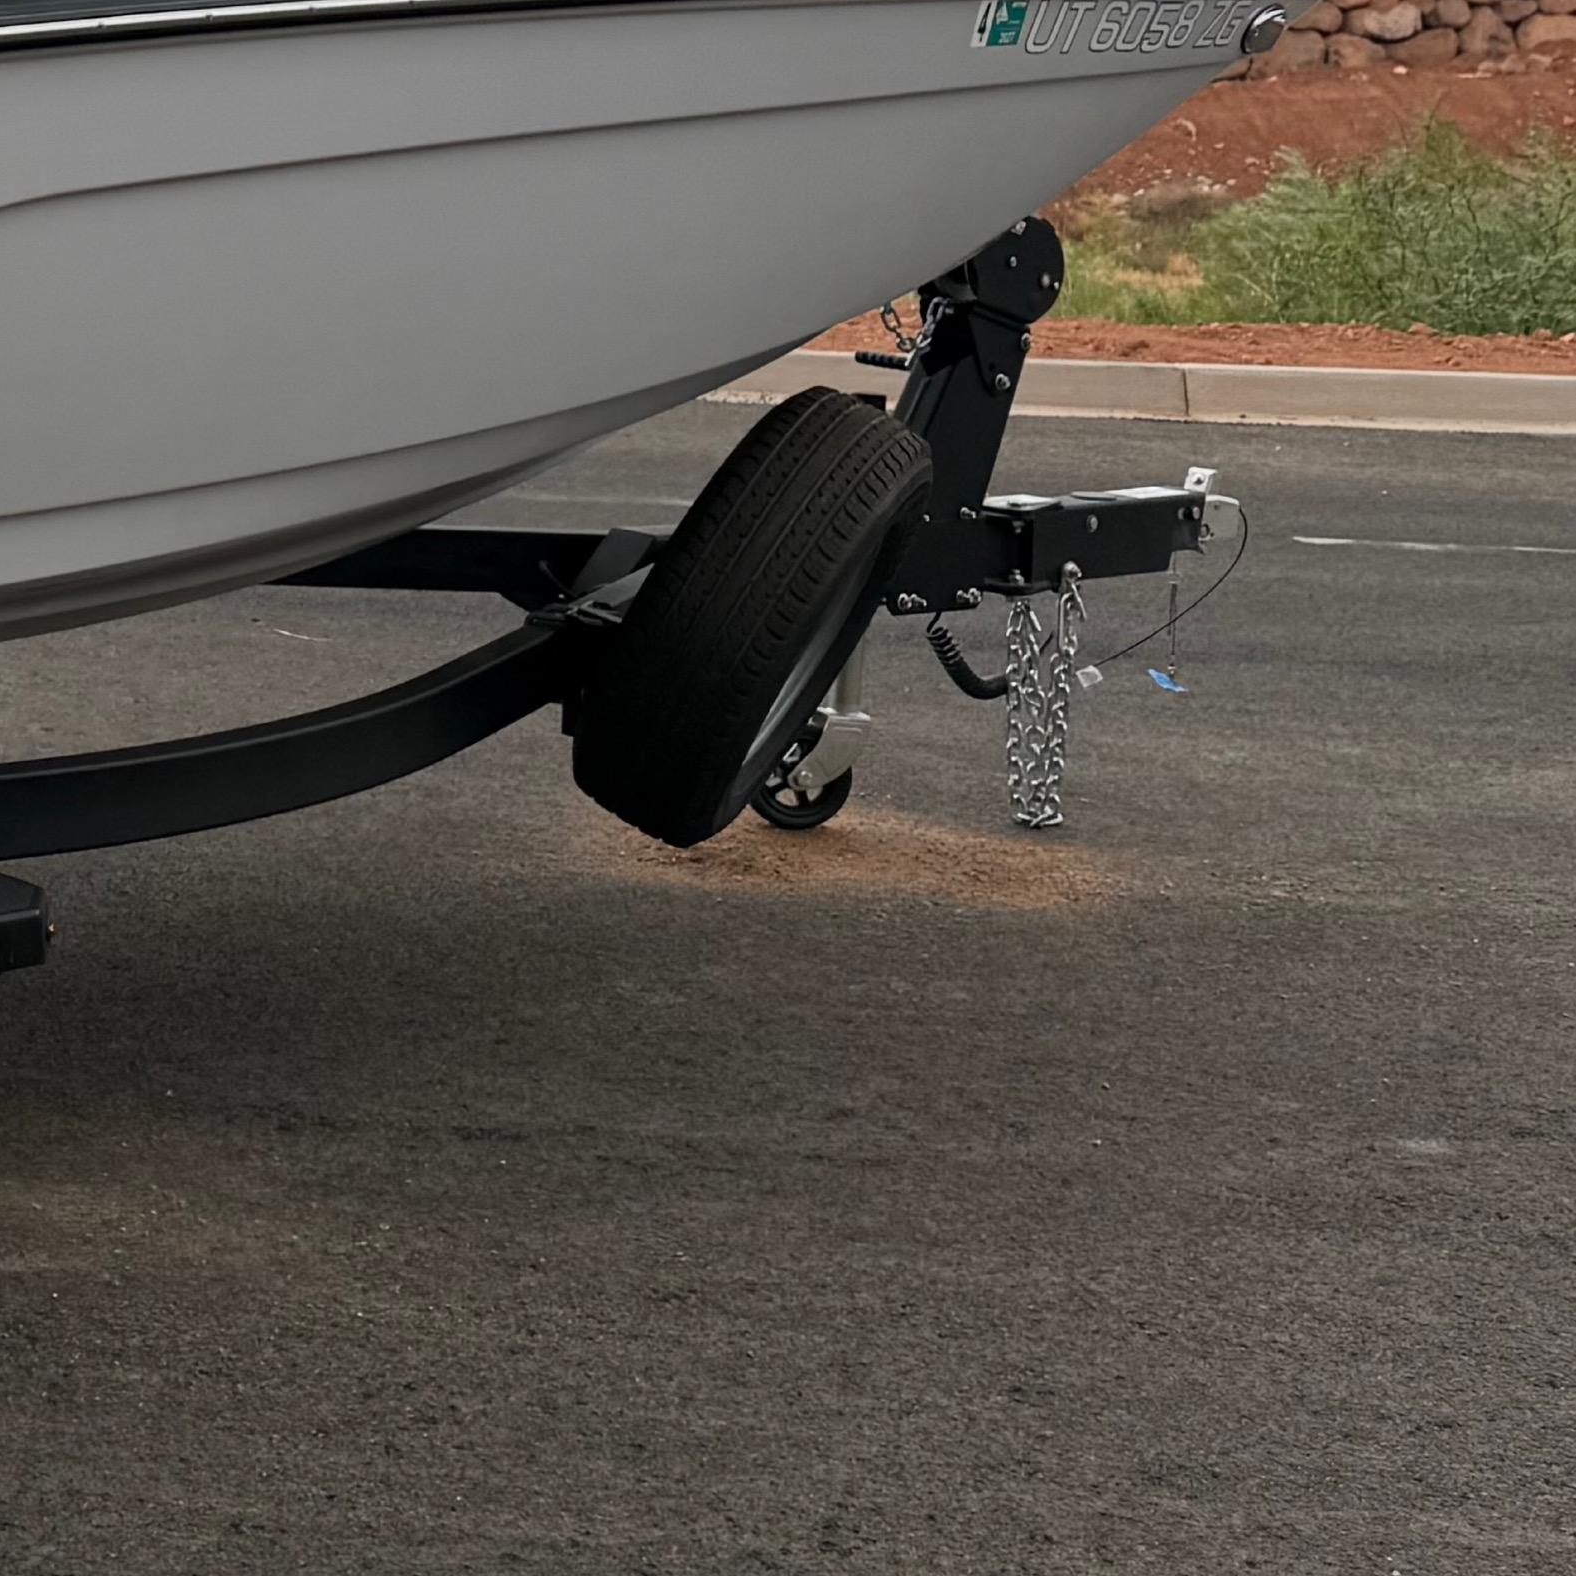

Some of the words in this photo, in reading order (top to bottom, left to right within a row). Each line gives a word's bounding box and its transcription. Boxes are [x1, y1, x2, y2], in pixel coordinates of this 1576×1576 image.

[1025, 0, 1099, 54] UT
[1088, 0, 1204, 53] 6058
[1192, 0, 1253, 49] ZG
